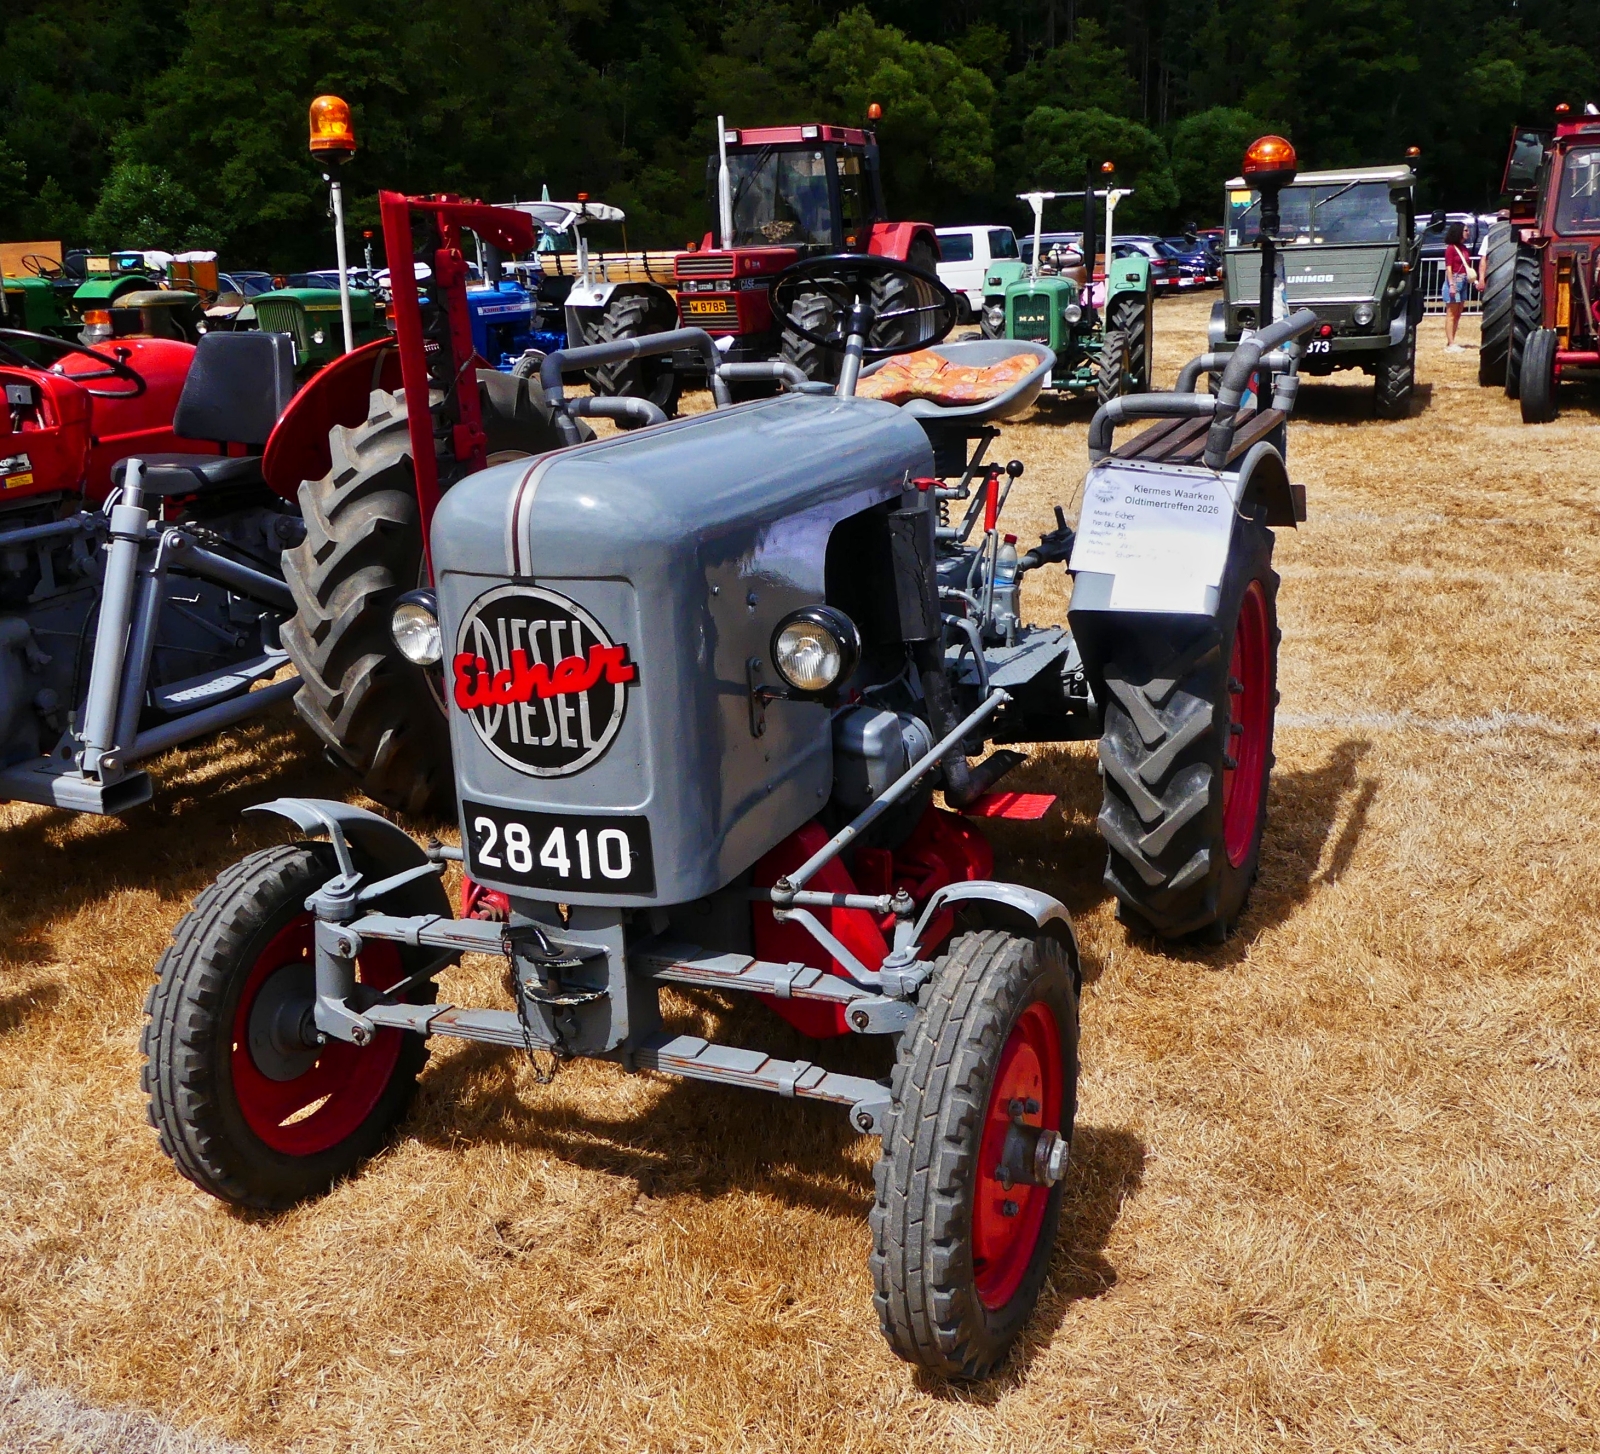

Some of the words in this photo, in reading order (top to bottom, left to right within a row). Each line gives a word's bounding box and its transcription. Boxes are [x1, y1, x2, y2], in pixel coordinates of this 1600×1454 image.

[1287, 274, 1334, 284] UNIMOG
[691, 302, 698, 312] W
[1133, 484, 1171, 497] Kiermes
[1174, 488, 1215, 501] Waarken
[1124, 496, 1195, 512] Oldtimertreffen
[1196, 504, 1219, 515] 2026
[453, 643, 635, 711] Eicher
[471, 616, 598, 749] DIESEL
[474, 816, 632, 880] 28410
